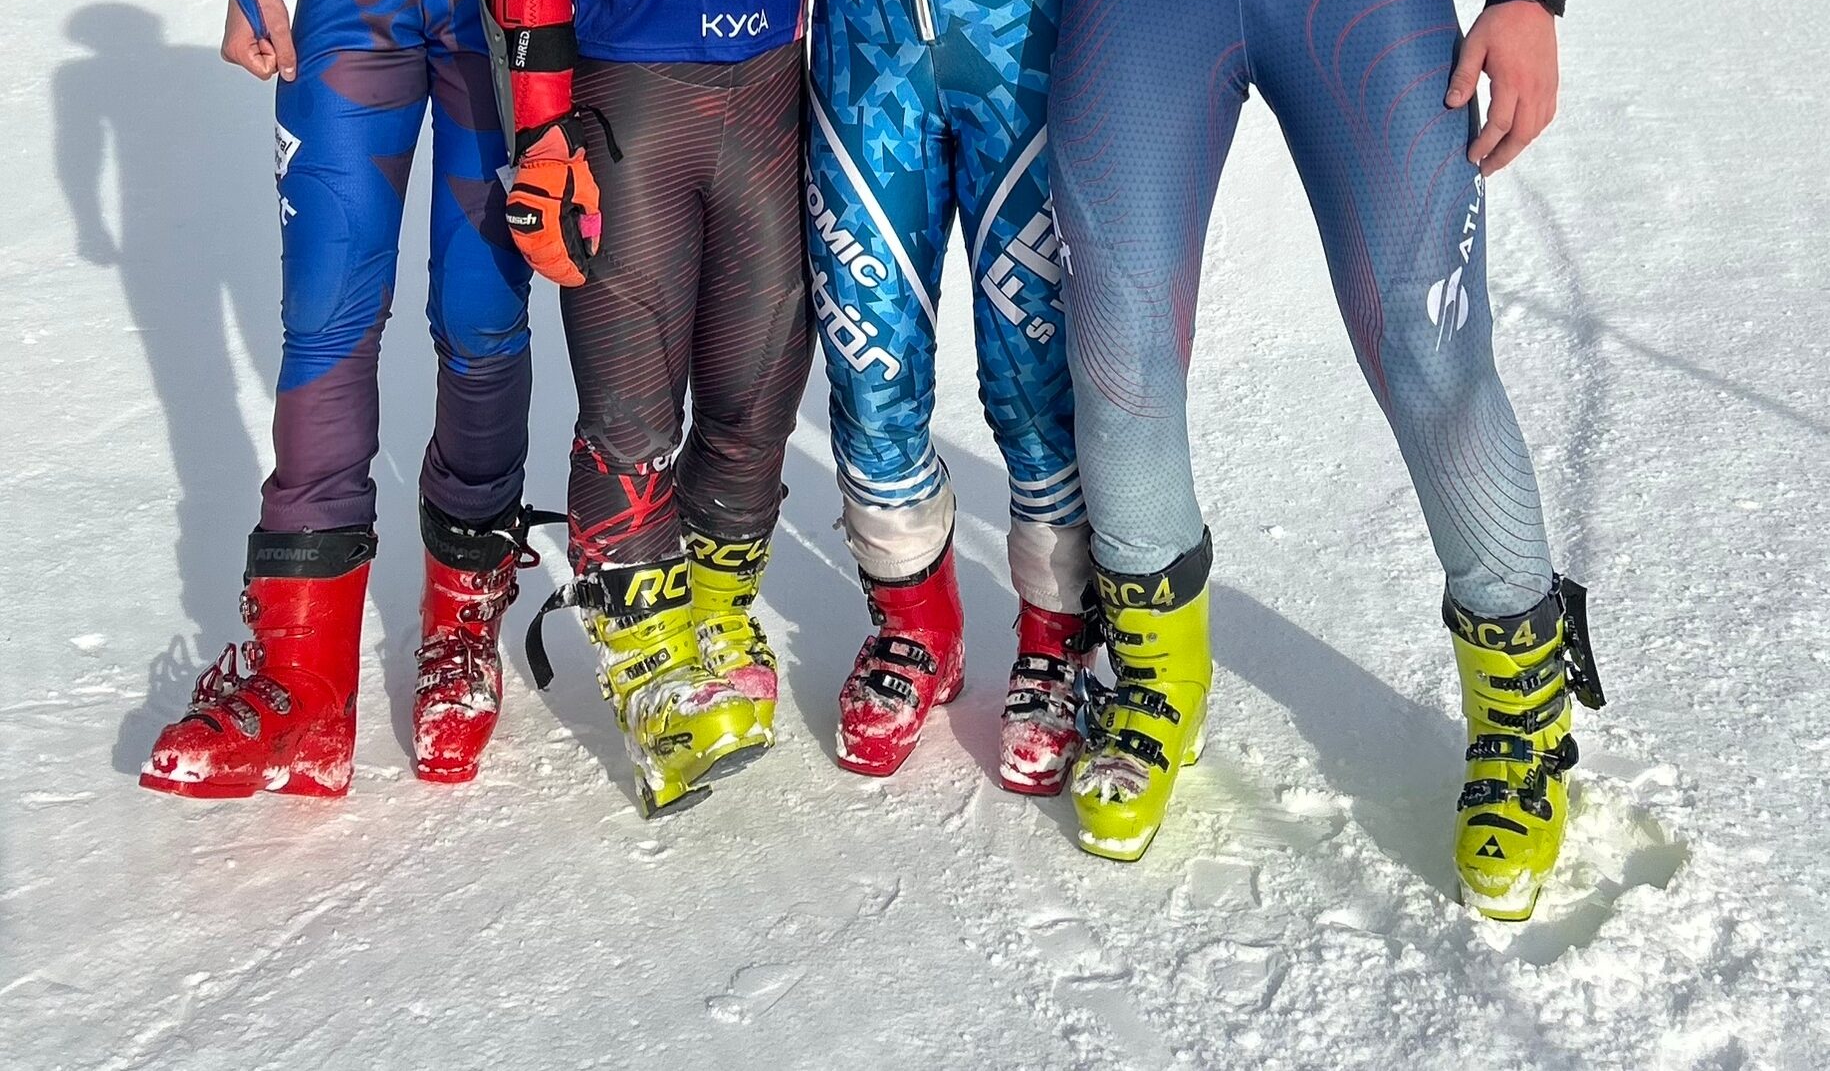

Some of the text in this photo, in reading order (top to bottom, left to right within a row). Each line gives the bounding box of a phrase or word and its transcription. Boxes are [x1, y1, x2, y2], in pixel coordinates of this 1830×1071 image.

[701, 8, 769, 37] КУСА
[505, 213, 538, 226] usch
[255, 547, 321, 562] ATOMIC
[625, 562, 688, 607] RC
[1097, 572, 1176, 614] RC4
[1455, 612, 1538, 651] RC4
